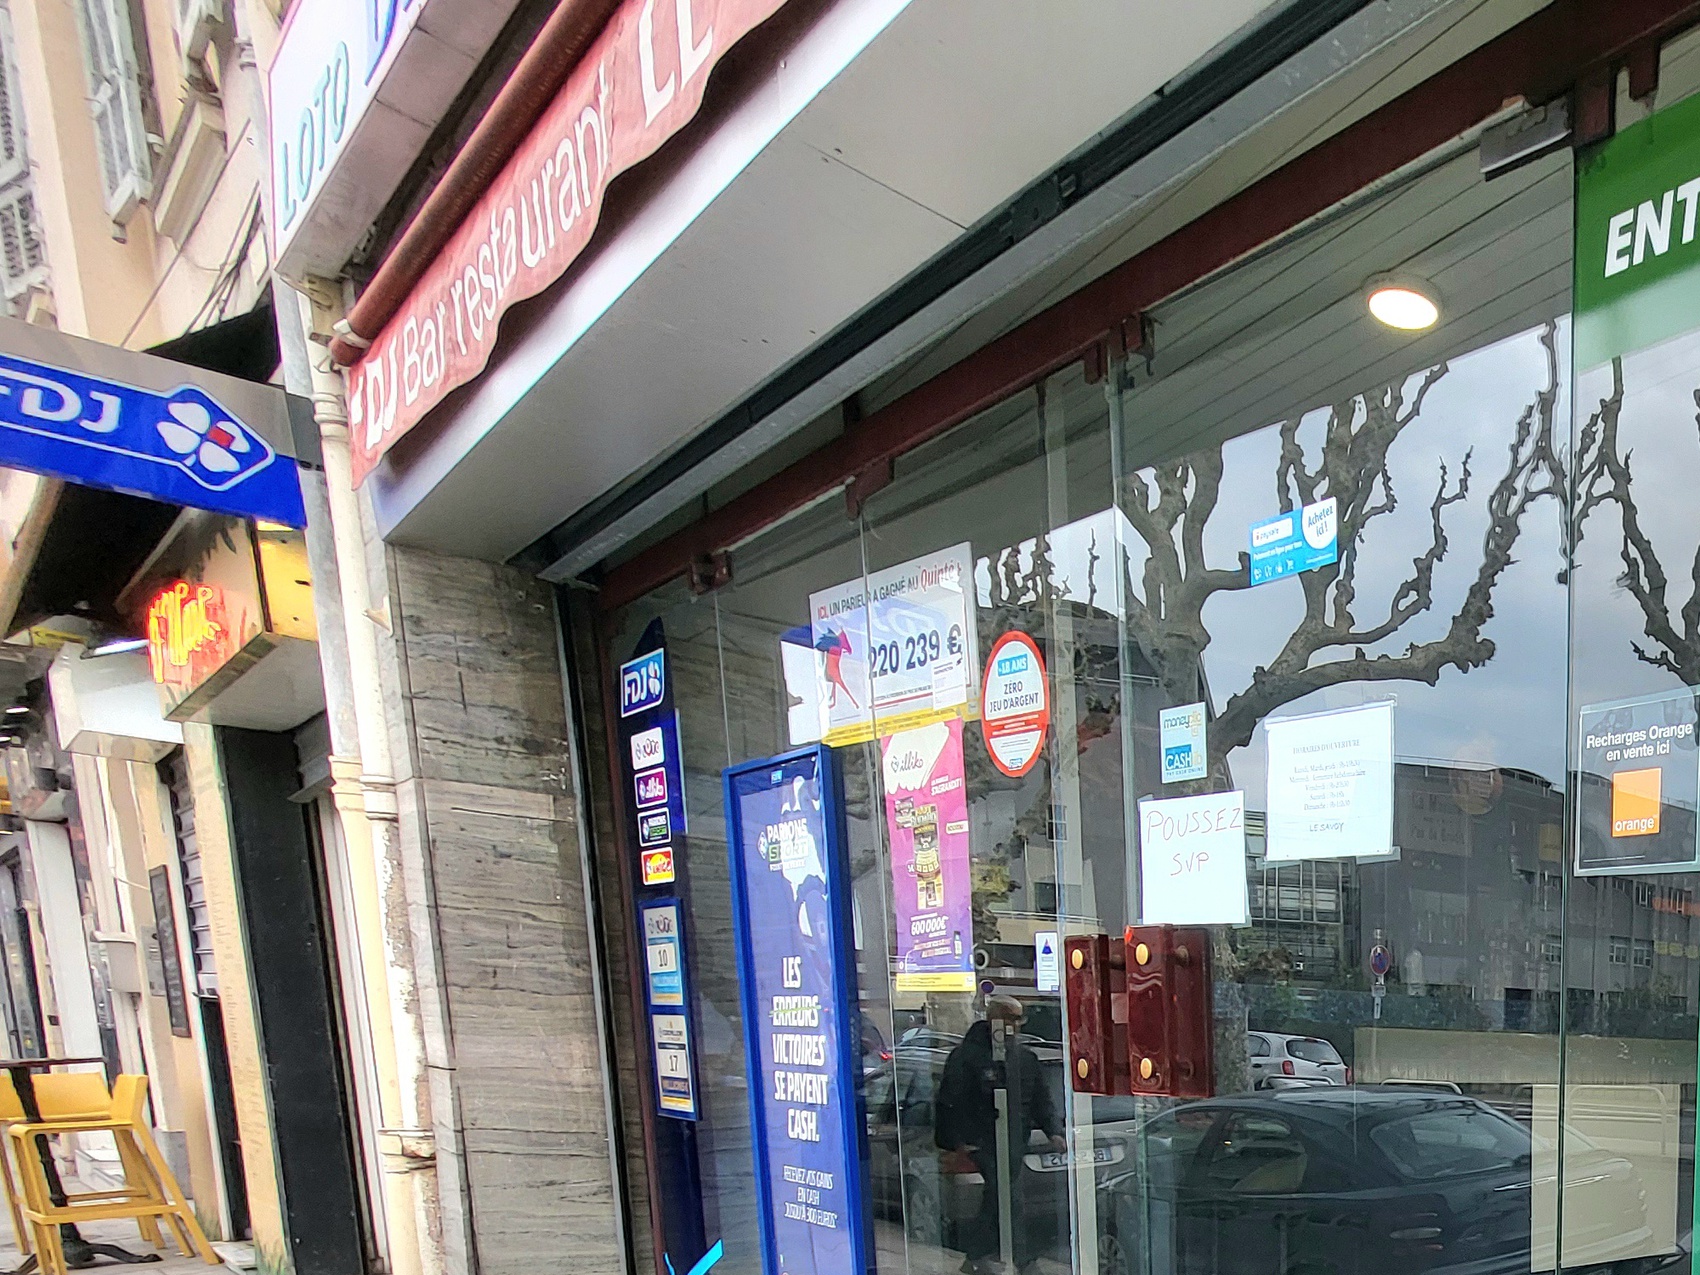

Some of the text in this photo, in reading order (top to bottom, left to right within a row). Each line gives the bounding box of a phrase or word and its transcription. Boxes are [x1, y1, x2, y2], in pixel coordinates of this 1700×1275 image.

[281, 41, 349, 231] LOTO
[402, 301, 447, 406] Bar
[449, 62, 609, 357] restaurant
[1307, 505, 1334, 528] Achetez
[829, 602, 841, 617] UN
[872, 589, 879, 604] A
[879, 576, 906, 600] GAGNÉ
[907, 576, 919, 592] AU
[869, 623, 962, 680] 220 239 €
[1011, 656, 1028, 673] ANS
[624, 667, 648, 706] FDJ
[1003, 679, 1024, 695] ZÉRO
[989, 692, 1039, 713] JEU D'ARGENT
[1586, 723, 1693, 750] Recharges Orange
[1606, 740, 1670, 762] en vente ici
[1146, 807, 1242, 844] POUSSEZ
[1319, 822, 1344, 833] SAVOY
[1614, 815, 1655, 832] orange
[1170, 851, 1210, 876] SVP
[658, 948, 668, 968] 10
[782, 956, 801, 989] LES
[771, 995, 819, 1028] ERREURS
[669, 1054, 679, 1073] 17
[772, 1033, 827, 1067] VICTOIRES
[774, 1071, 829, 1106] SE PAYENT
[787, 1107, 820, 1142] CASH.
